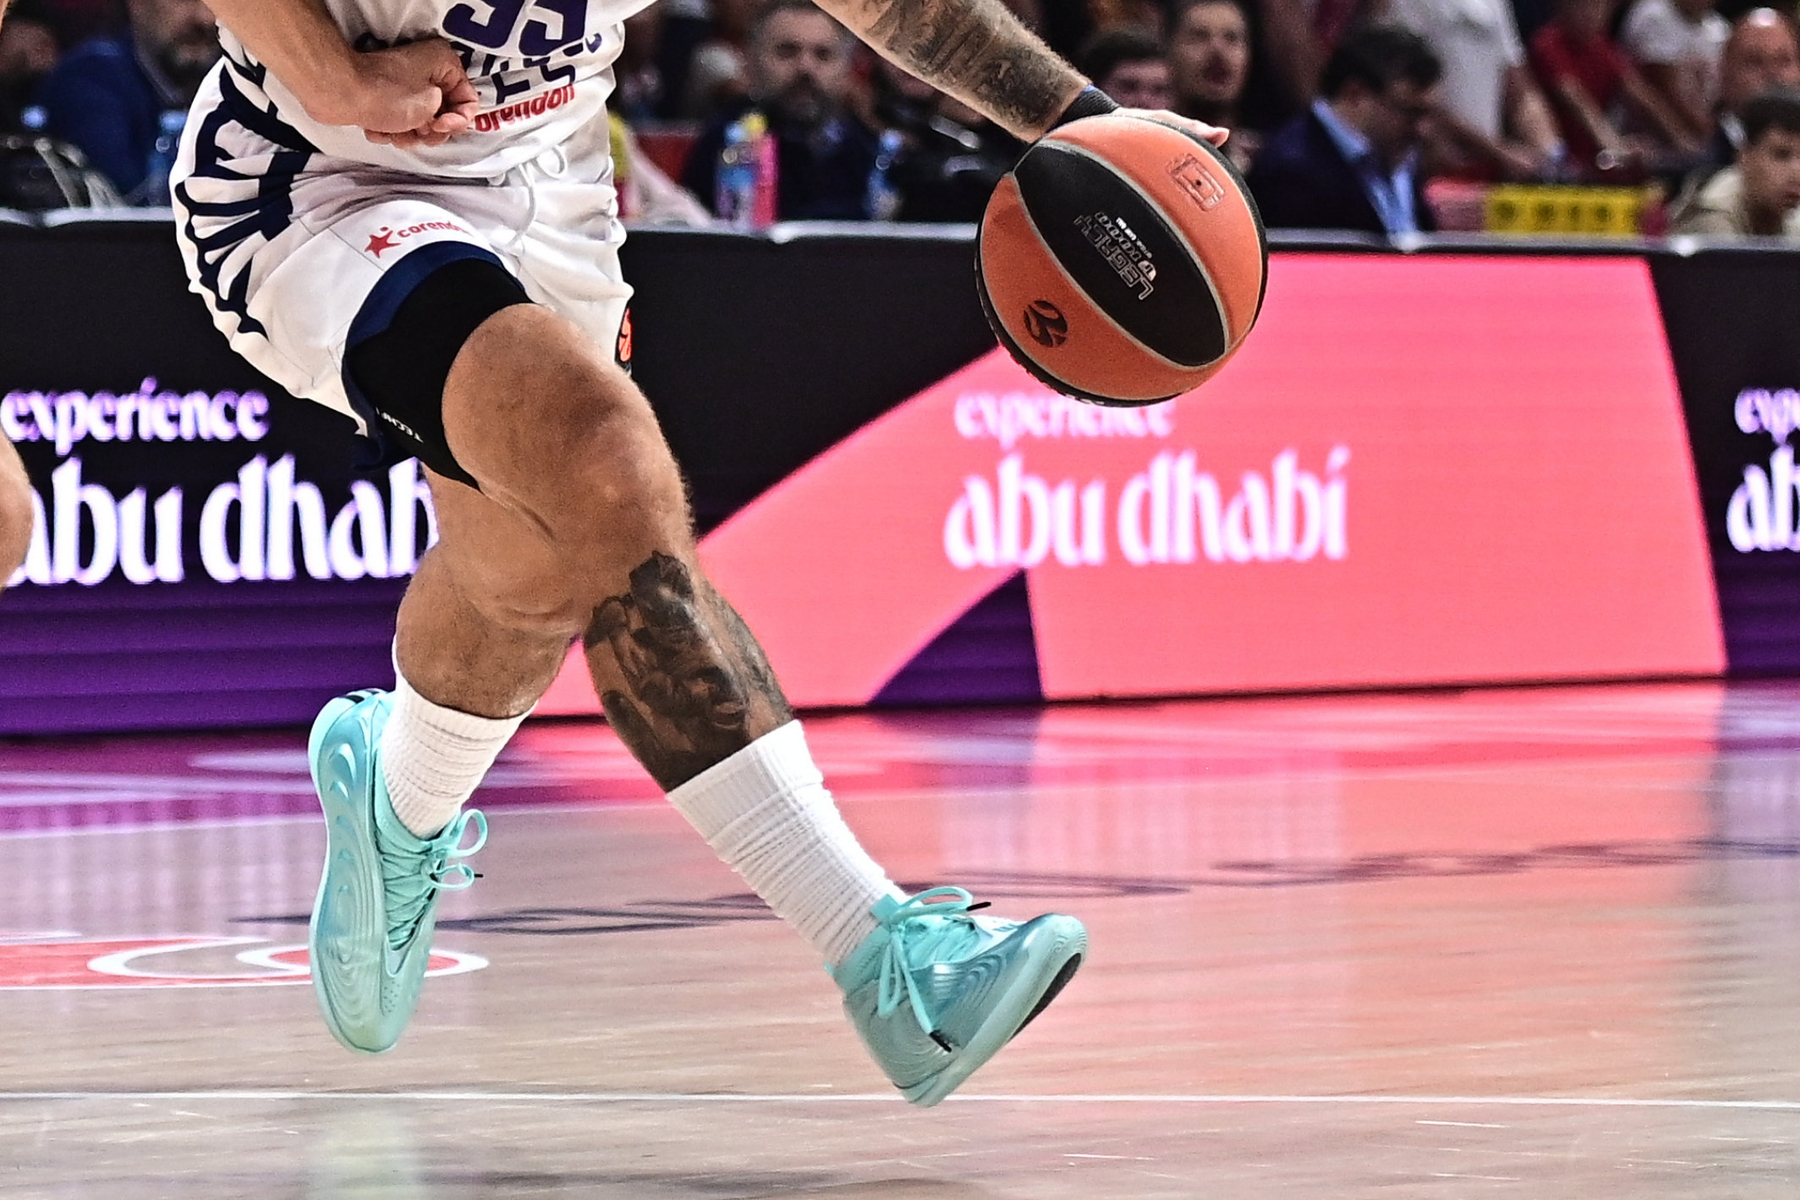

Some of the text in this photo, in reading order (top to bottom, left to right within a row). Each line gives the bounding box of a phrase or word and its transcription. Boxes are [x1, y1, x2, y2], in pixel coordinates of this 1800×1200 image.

[474, 84, 576, 133] orendon
[1073, 215, 1154, 300] LEGACY
[0, 376, 270, 456] experience
[199, 452, 440, 583] dhab
[943, 452, 1106, 568] abu
